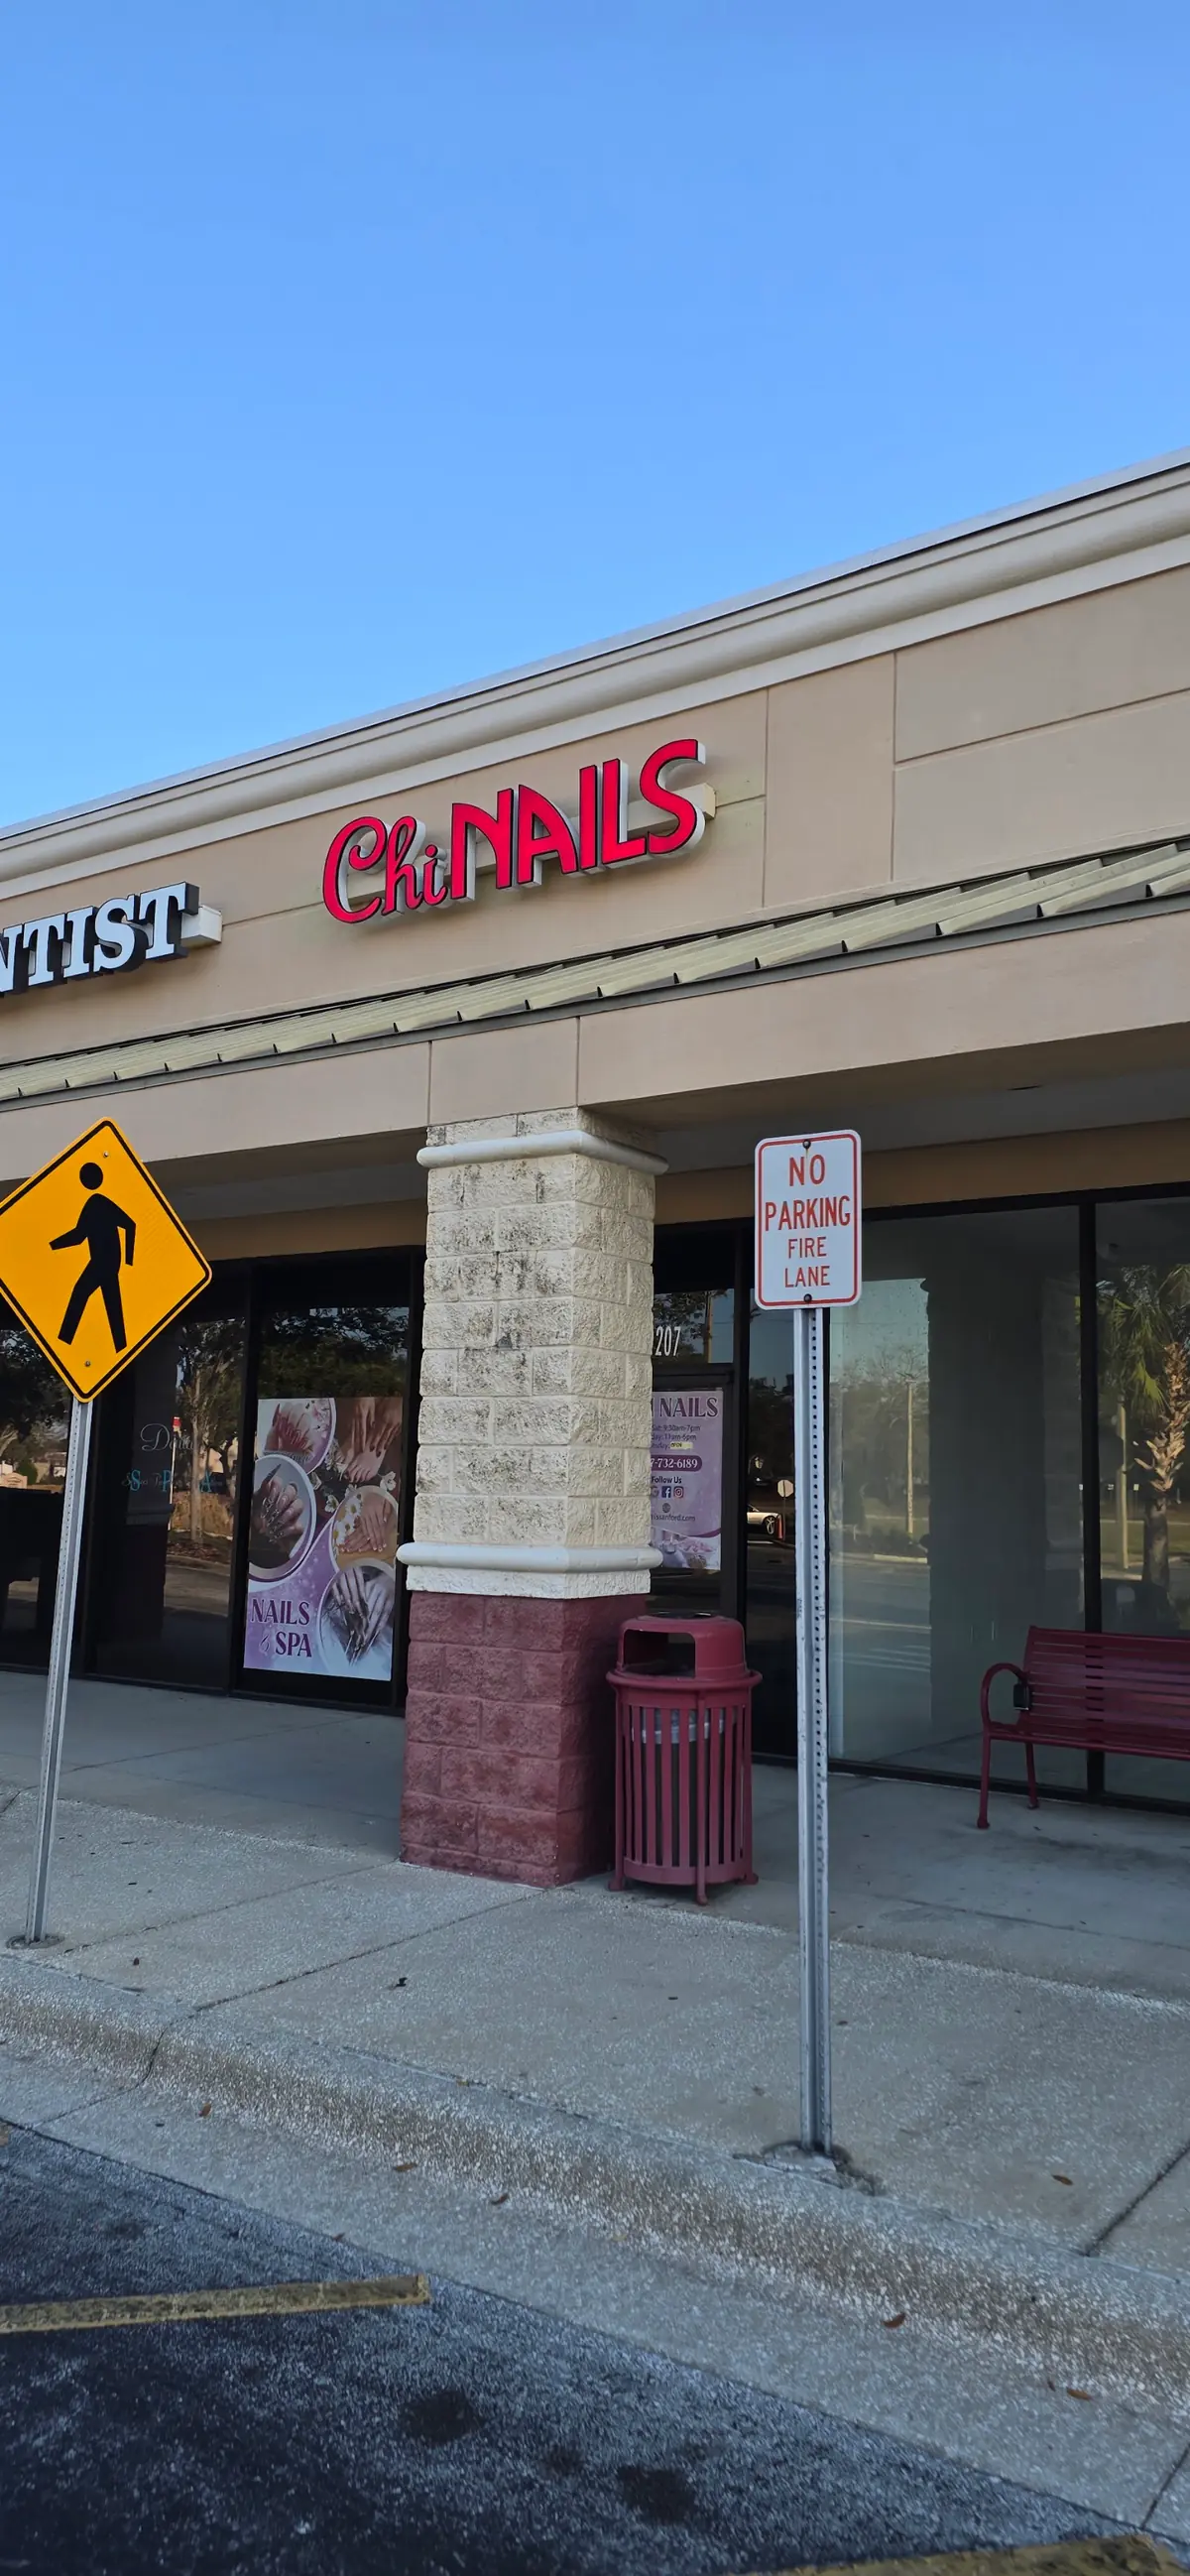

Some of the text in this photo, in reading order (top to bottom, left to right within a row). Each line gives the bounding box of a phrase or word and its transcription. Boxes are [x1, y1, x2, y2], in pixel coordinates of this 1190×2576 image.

[322, 738, 702, 924] Chi NAILS
[789, 1154, 826, 1187] NO
[765, 1195, 851, 1232] PARKING
[787, 1236, 827, 1259] FIRE
[784, 1265, 830, 1288] LANE
[654, 1325, 681, 1357] 207
[659, 1397, 719, 1417] NAILS
[251, 1598, 310, 1626] NAILS
[275, 1631, 312, 1657] SPA
